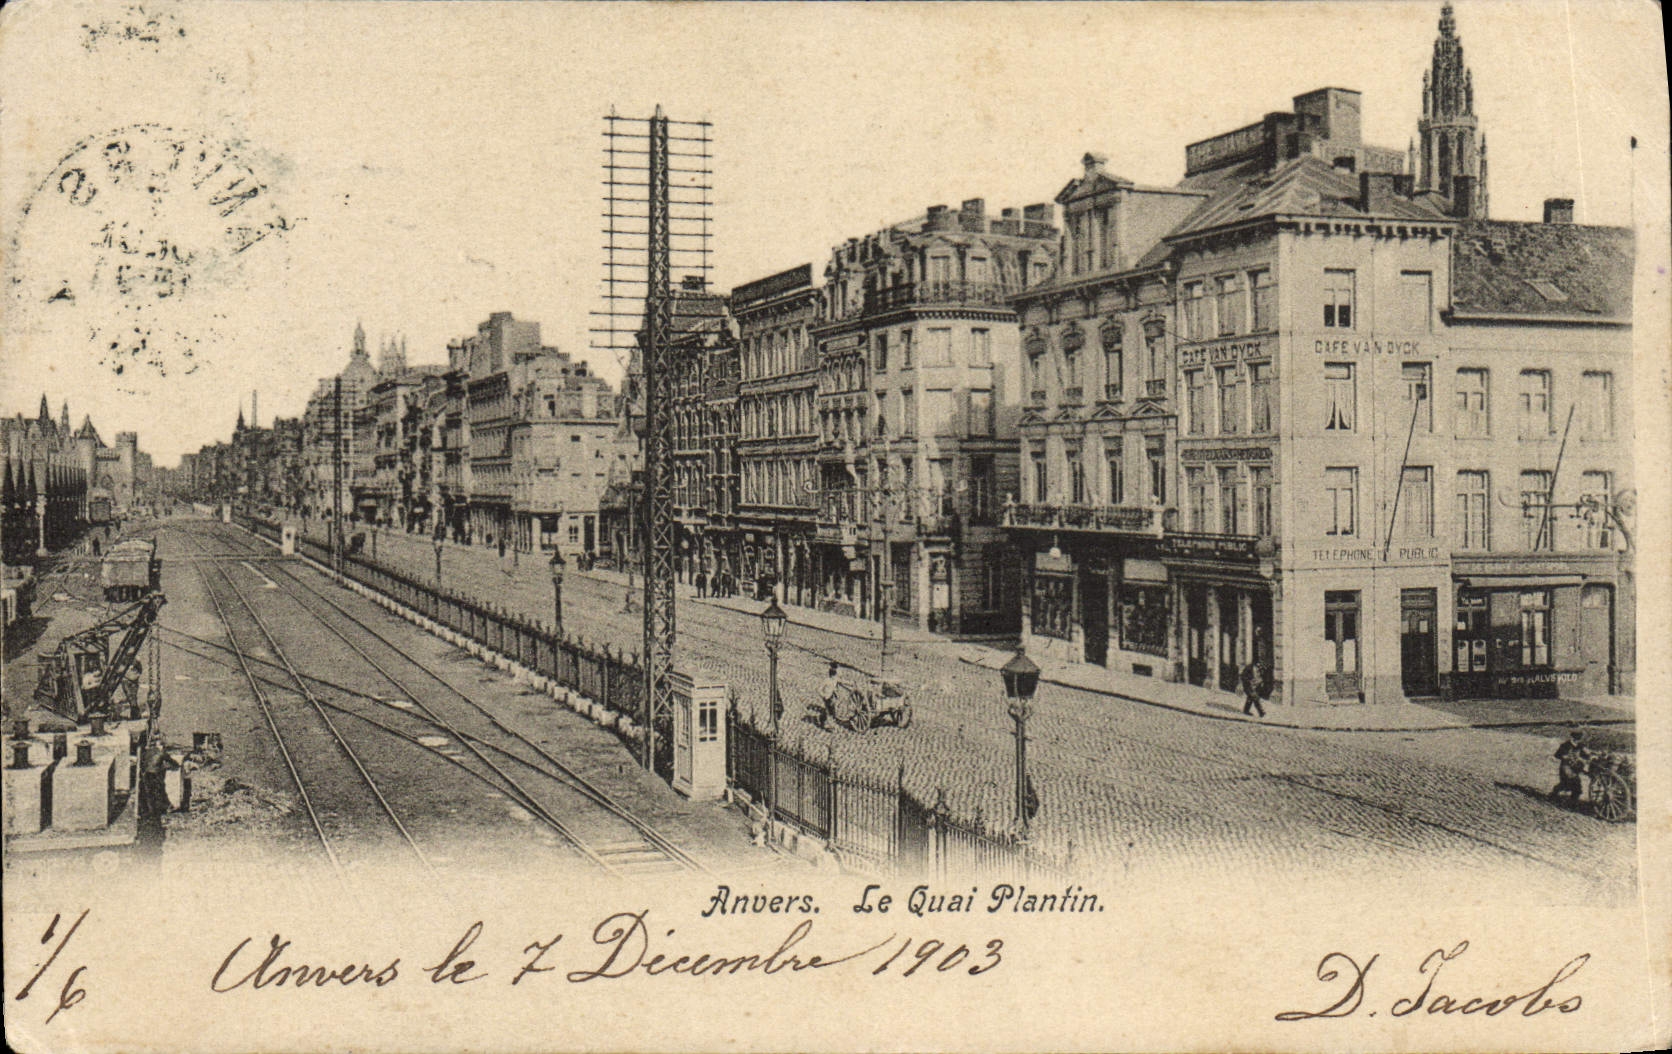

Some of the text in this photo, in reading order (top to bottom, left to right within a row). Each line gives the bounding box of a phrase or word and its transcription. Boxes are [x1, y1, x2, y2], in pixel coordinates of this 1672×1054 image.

[1353, 340, 1383, 355] VAN
[1387, 341, 1420, 356] DYCK
[1313, 548, 1372, 561] TELEPHONE
[1400, 546, 1439, 560] PUBLIC
[211, 933, 400, 994] Anvers
[421, 920, 489, 986] le
[511, 937, 563, 986] 7
[872, 936, 1004, 979] 1903
[1391, 939, 1592, 1018] Jacobs
